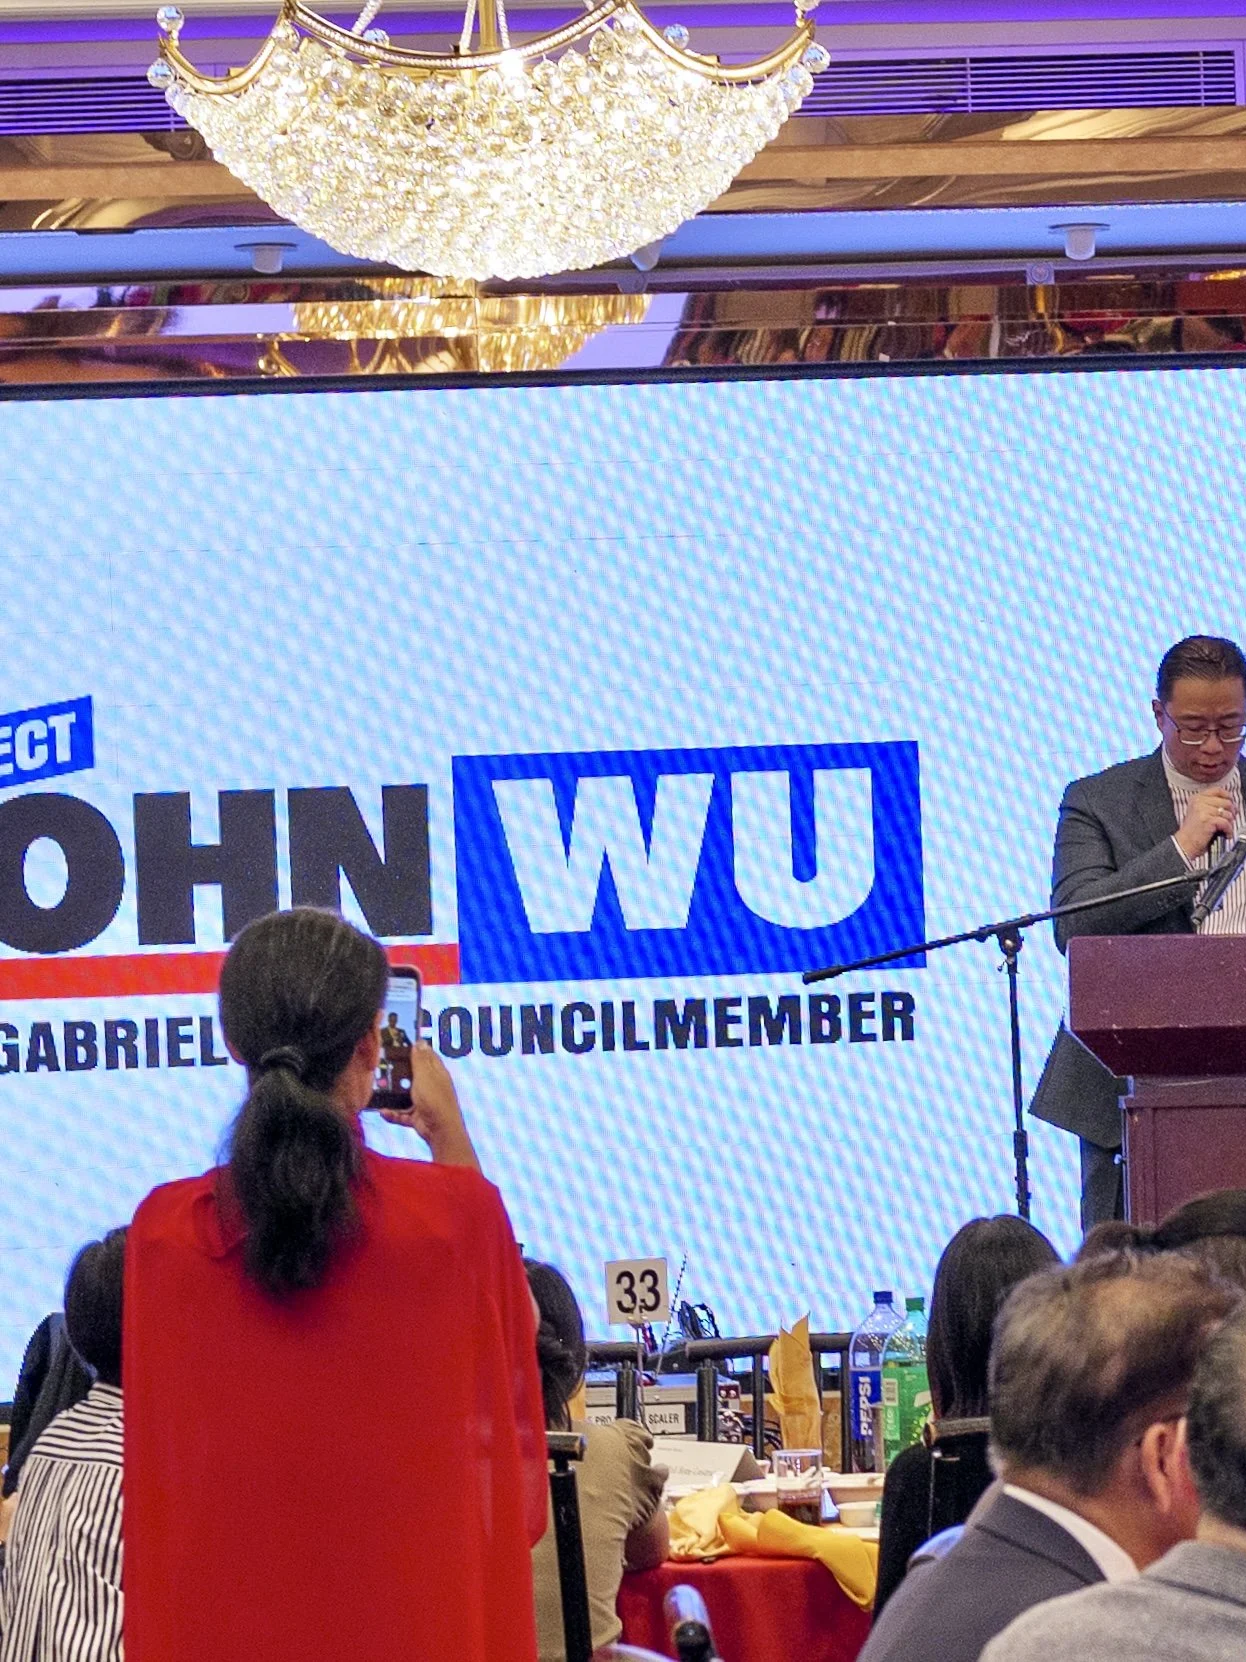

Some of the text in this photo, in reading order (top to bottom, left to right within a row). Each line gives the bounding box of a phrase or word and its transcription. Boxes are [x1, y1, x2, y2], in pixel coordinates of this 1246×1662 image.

[491, 767, 875, 934] WU
[616, 1269, 661, 1313] 33
[648, 1413, 679, 1425] SCALER
